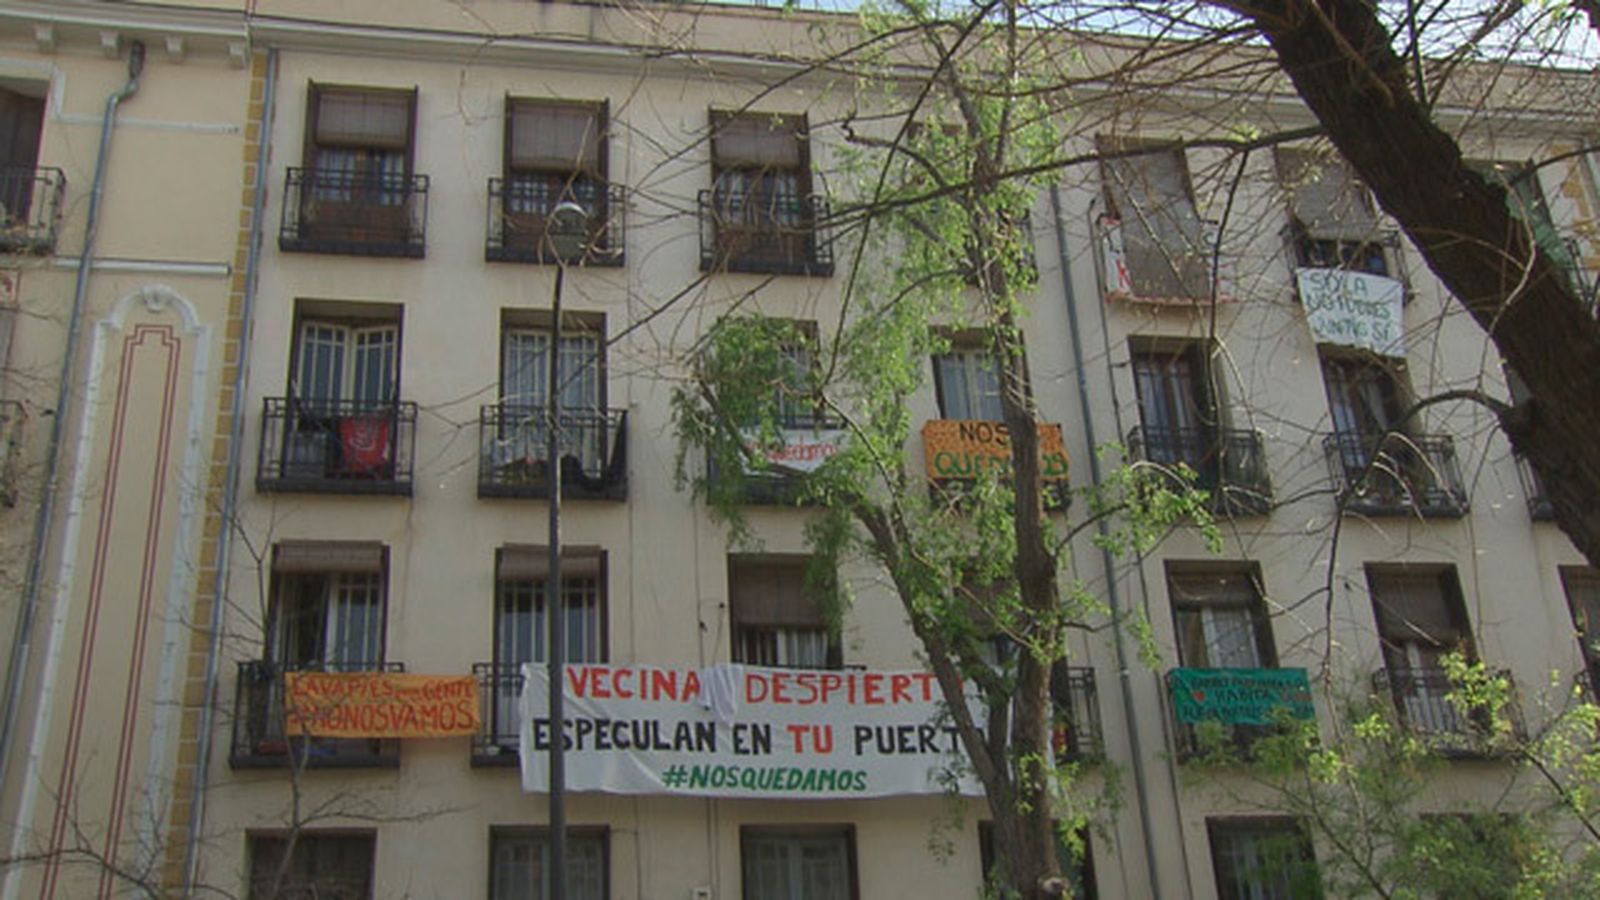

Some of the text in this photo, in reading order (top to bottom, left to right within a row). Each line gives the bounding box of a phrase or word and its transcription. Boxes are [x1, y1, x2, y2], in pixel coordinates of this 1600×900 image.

[959, 421, 1011, 445] NOS
[567, 667, 964, 704] VECINA DESPIERT
[533, 718, 716, 751] ESPECULAN
[733, 724, 771, 754] EN
[787, 725, 833, 753] TU
[662, 765, 867, 791] #NOSQUEDAMOS
